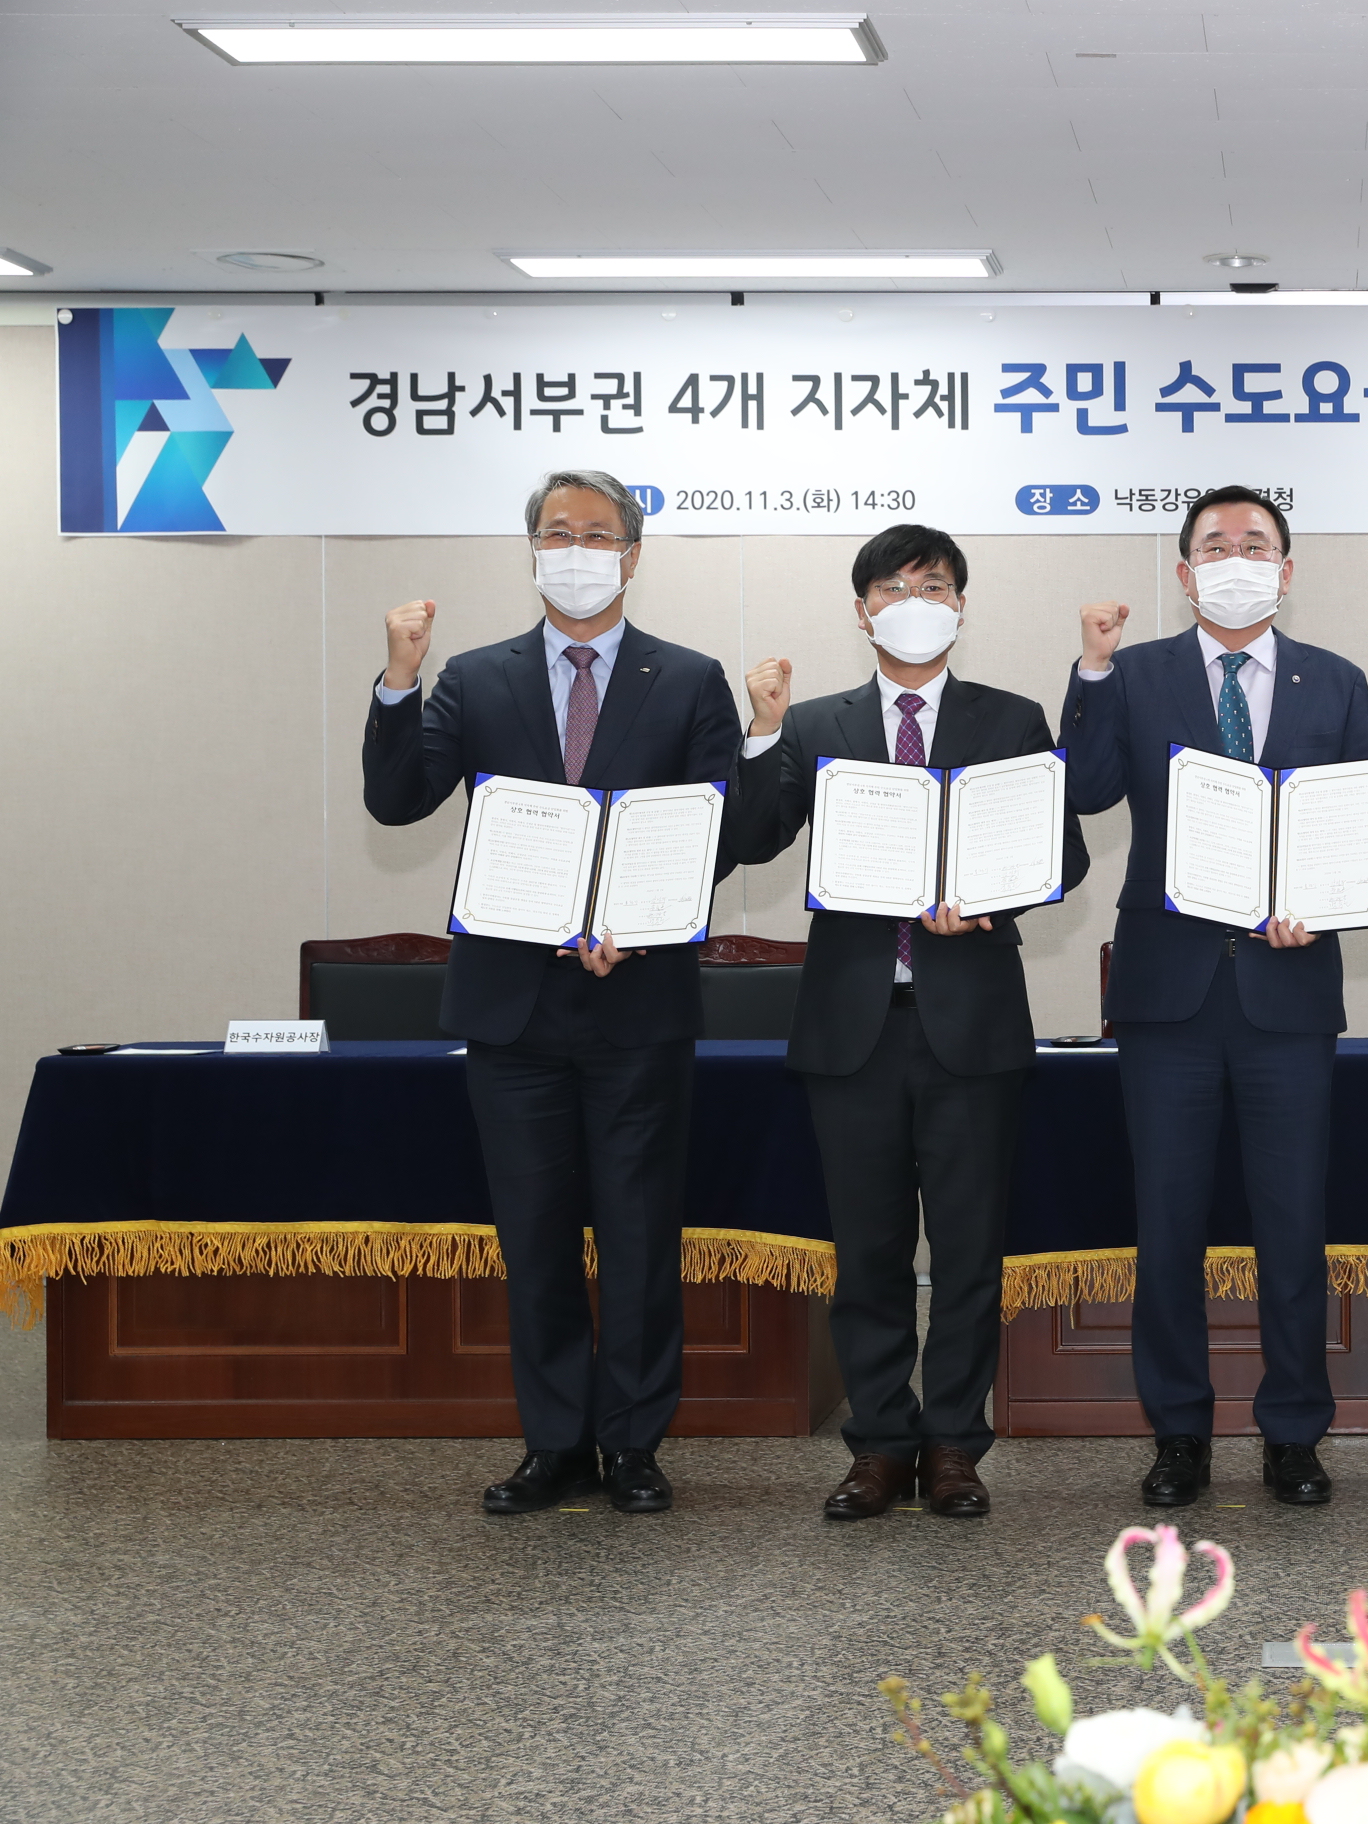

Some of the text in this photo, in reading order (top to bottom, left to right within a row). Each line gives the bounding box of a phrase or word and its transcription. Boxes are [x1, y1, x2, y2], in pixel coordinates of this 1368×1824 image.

[349, 371, 644, 437] 경남서부권
[668, 372, 765, 431] 4개
[790, 368, 970, 431] 지자체
[993, 360, 1129, 436] 주민
[676, 488, 916, 513] 2020.11.3.(화) 14:30
[229, 1032, 321, 1043] 한국수자원공사장
